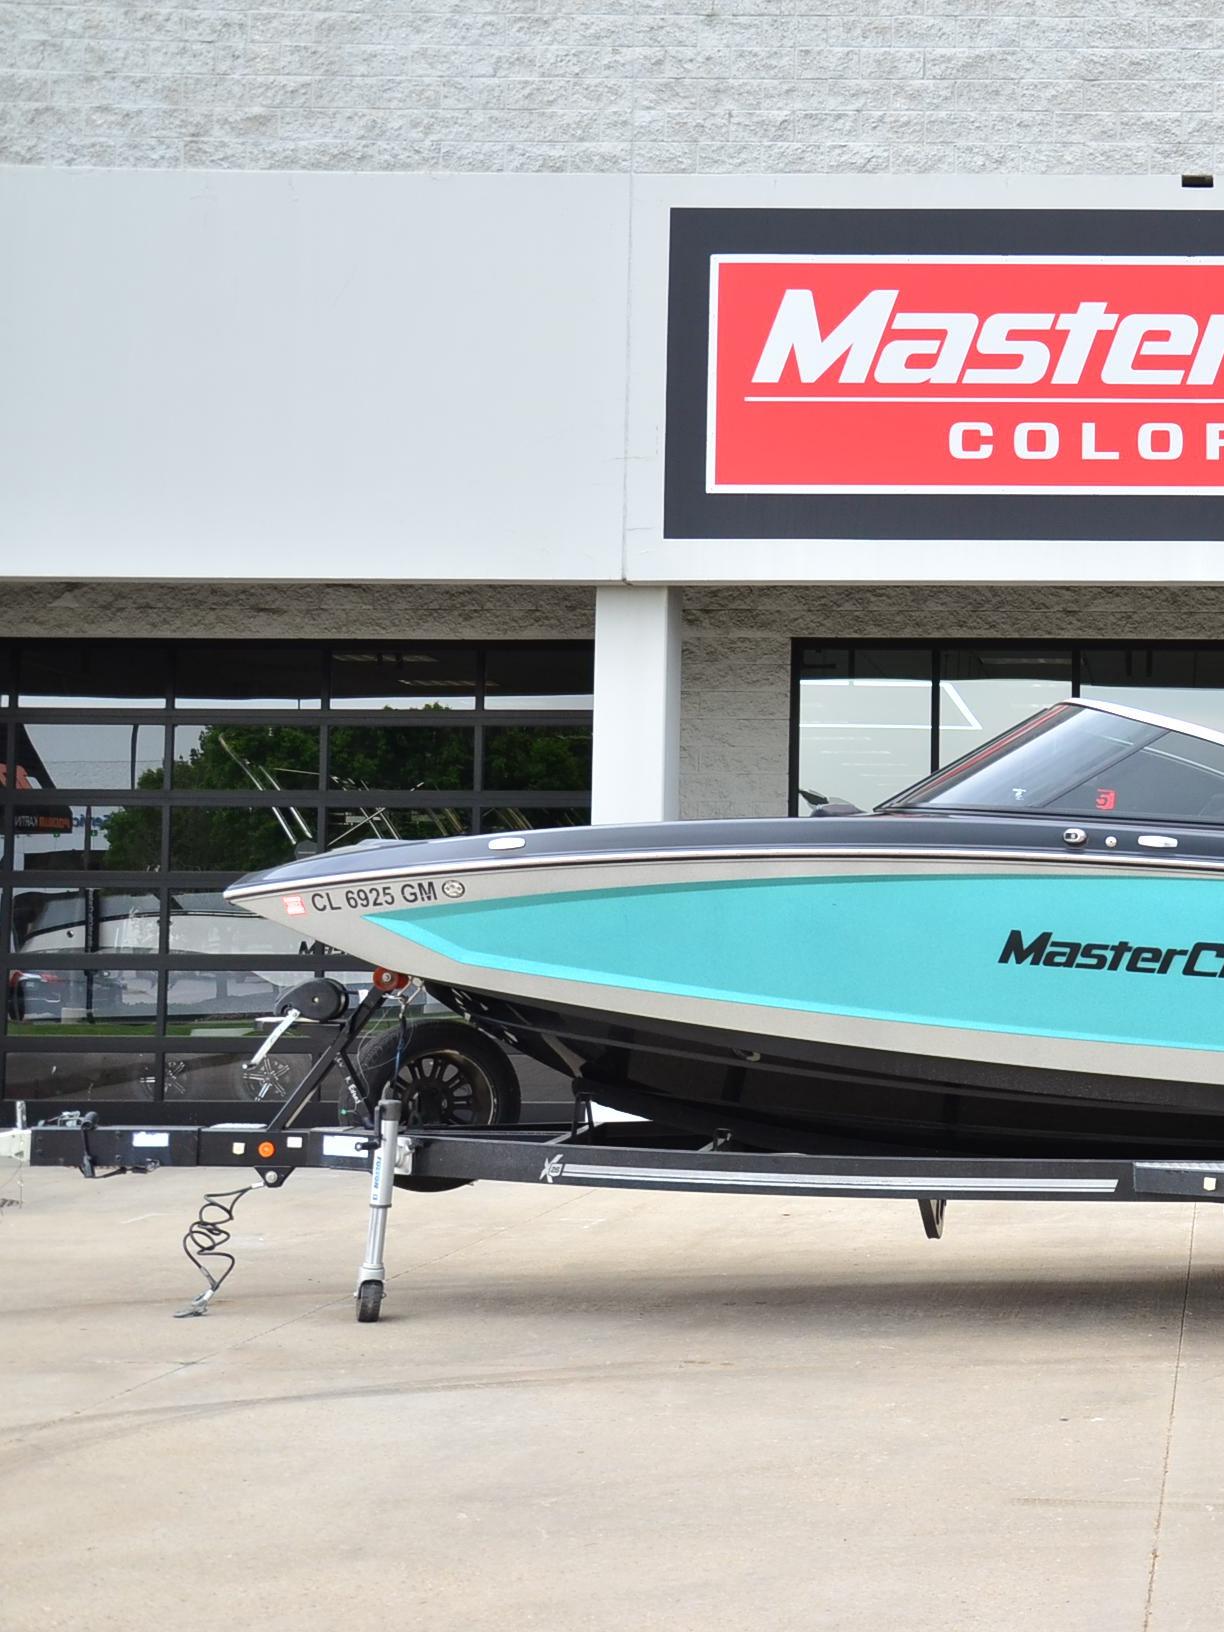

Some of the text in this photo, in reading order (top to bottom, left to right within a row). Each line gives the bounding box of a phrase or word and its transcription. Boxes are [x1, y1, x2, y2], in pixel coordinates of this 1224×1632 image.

[311, 892, 342, 912] CL
[345, 886, 395, 909] 6925
[401, 881, 438, 903] GM
